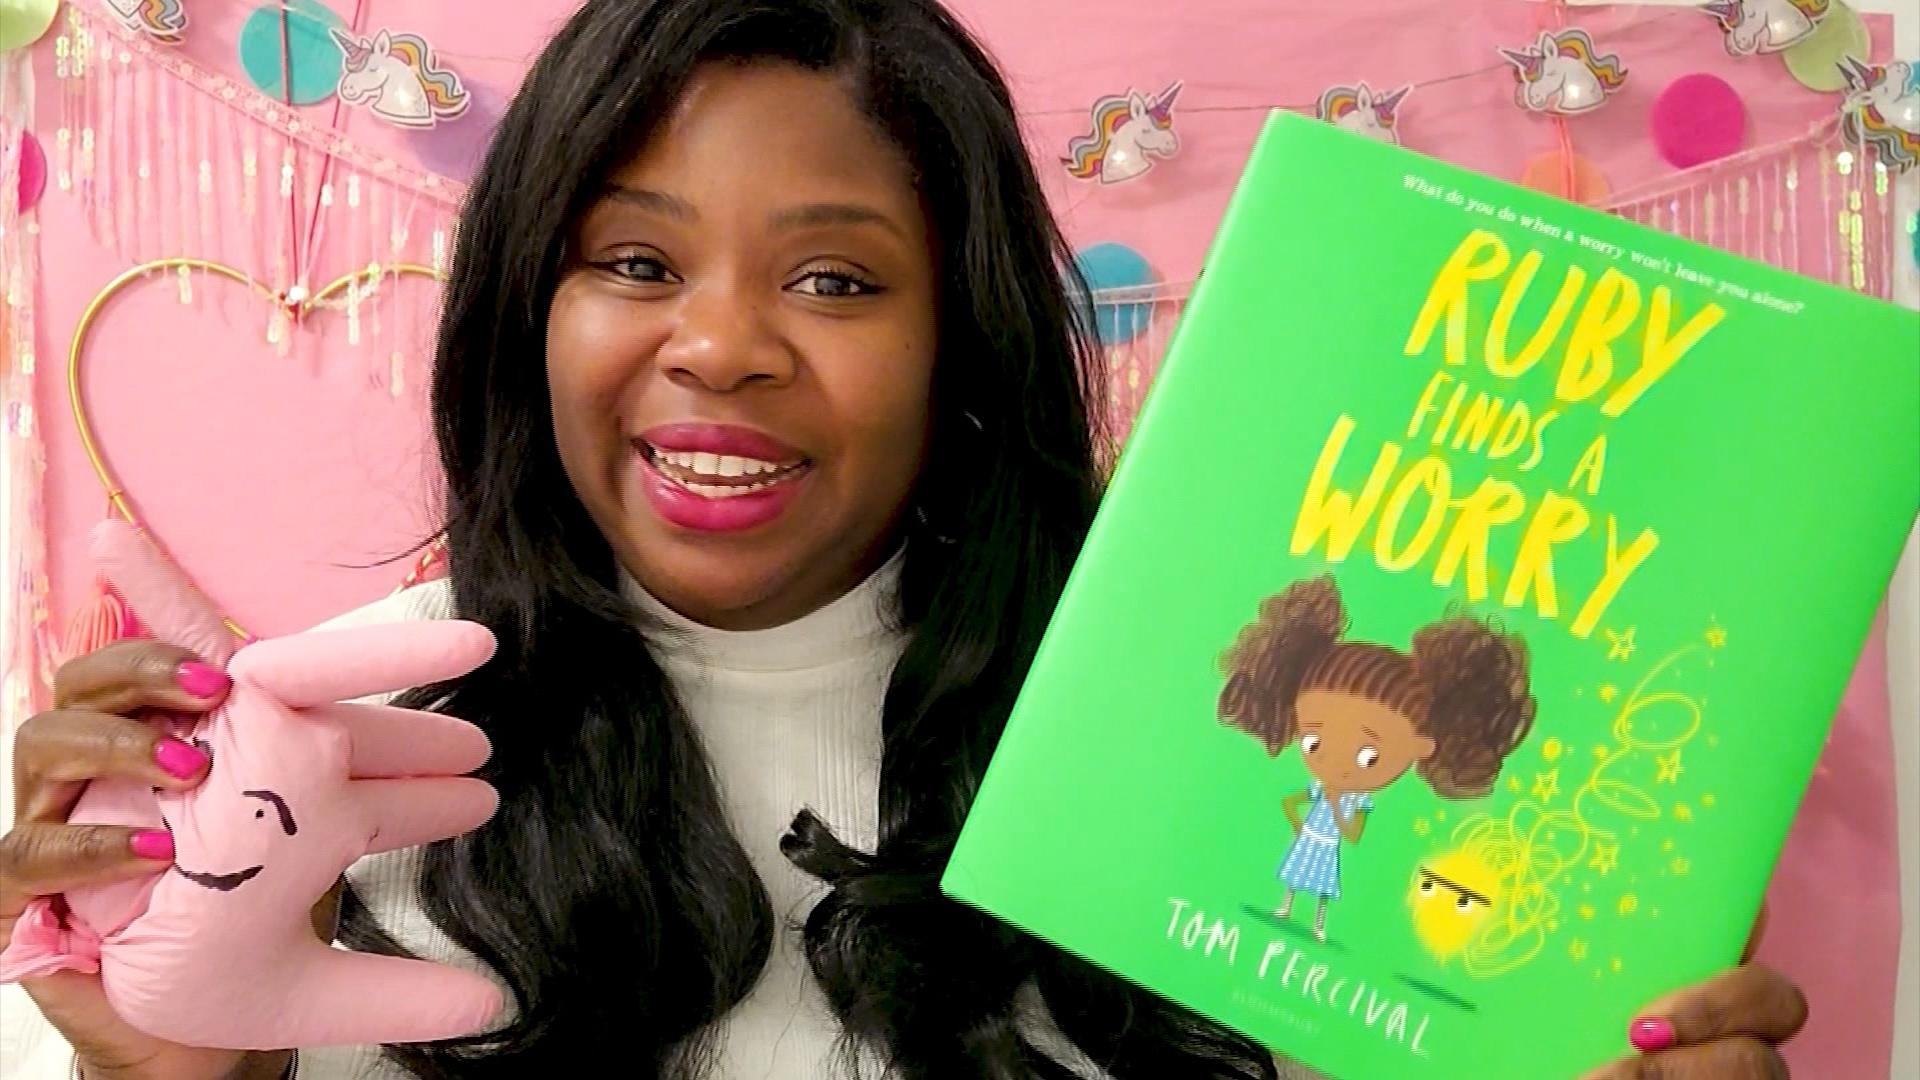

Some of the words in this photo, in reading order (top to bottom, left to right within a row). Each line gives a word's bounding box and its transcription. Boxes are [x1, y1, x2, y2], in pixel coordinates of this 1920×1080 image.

[1403, 174, 1443, 198] What
[1445, 190, 1465, 206] do
[1464, 198, 1495, 216] you
[1497, 206, 1517, 222] do
[1519, 215, 1561, 239] when
[1563, 230, 1574, 243] a
[1579, 235, 1625, 260] worry
[1631, 250, 1671, 273] won't
[1674, 262, 1715, 287] leave
[1716, 280, 1749, 300] you
[1751, 291, 1805, 314] alone?
[1404, 229, 1727, 417] RUBY
[1407, 370, 1561, 471] FINDS
[1567, 434, 1608, 496] A
[1288, 412, 1661, 639] WORRY
[1166, 897, 1241, 967] TOM
[1258, 939, 1430, 1059] PERCIVAL
